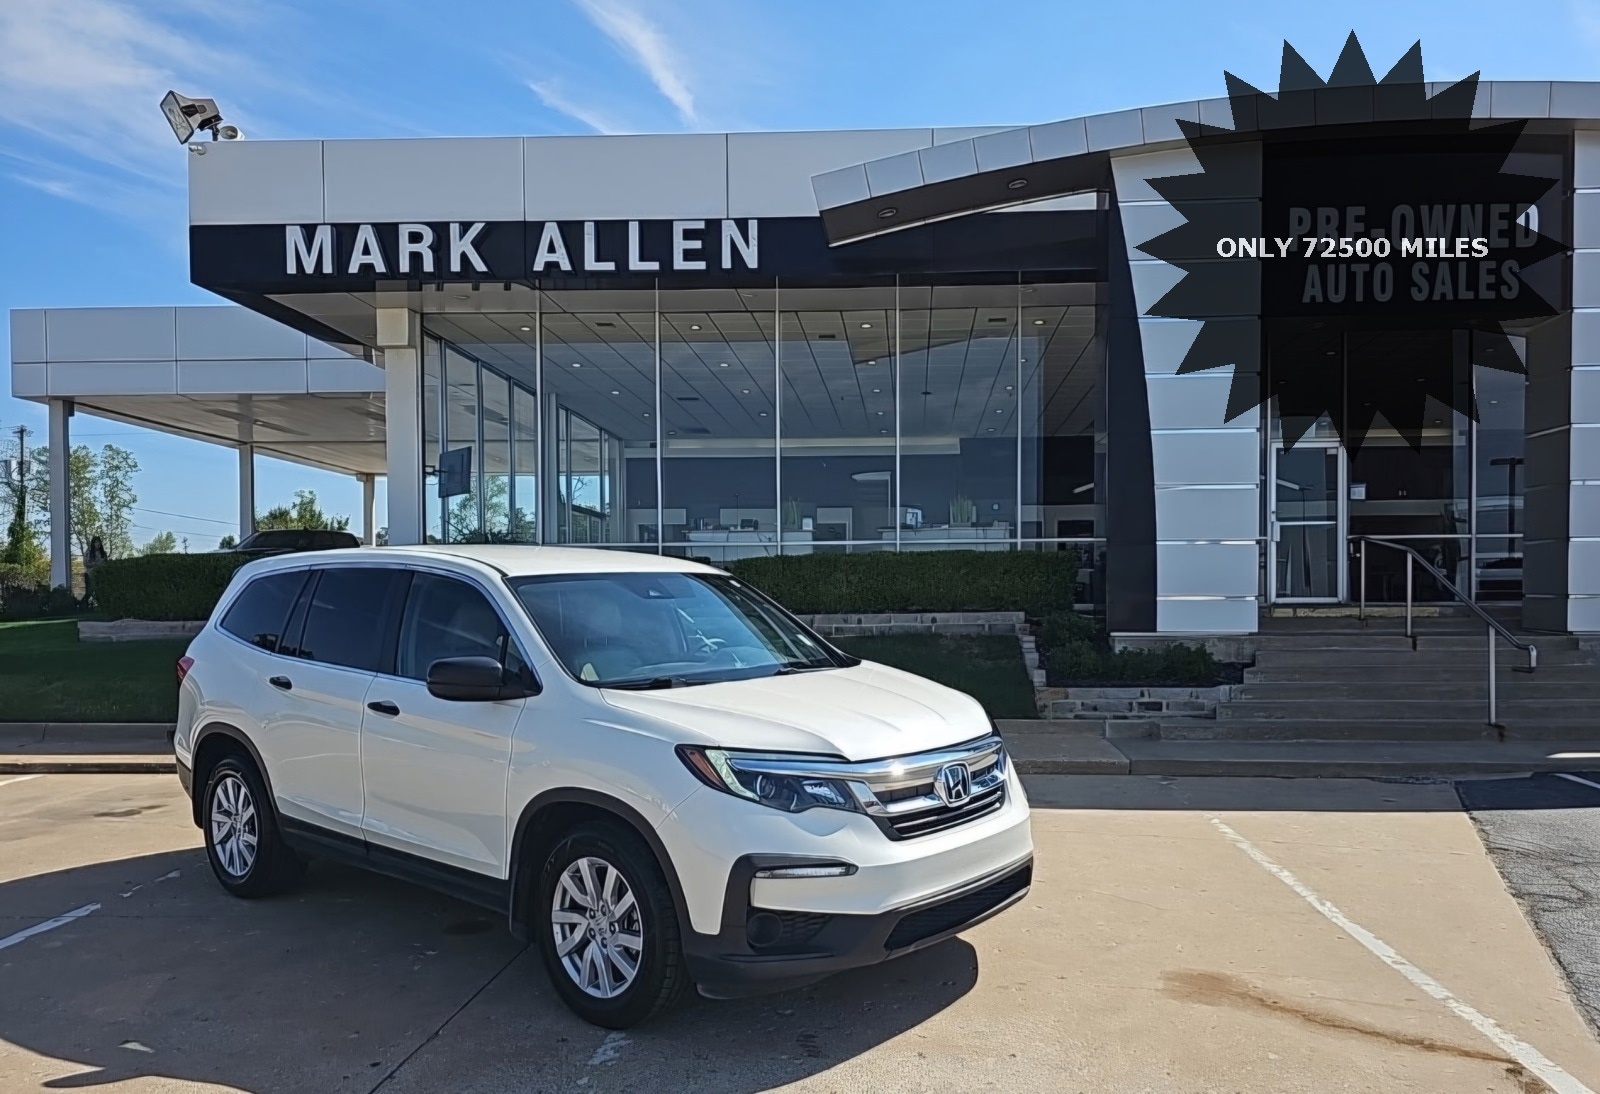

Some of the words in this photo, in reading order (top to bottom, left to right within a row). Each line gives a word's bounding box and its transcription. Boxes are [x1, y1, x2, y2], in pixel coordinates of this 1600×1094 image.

[285, 223, 489, 275] MARK
[533, 219, 759, 272] ALLEN
[1289, 203, 1539, 252] PRE-OWNED
[1303, 262, 1394, 303] AUTO
[1410, 260, 1520, 300] SALES
